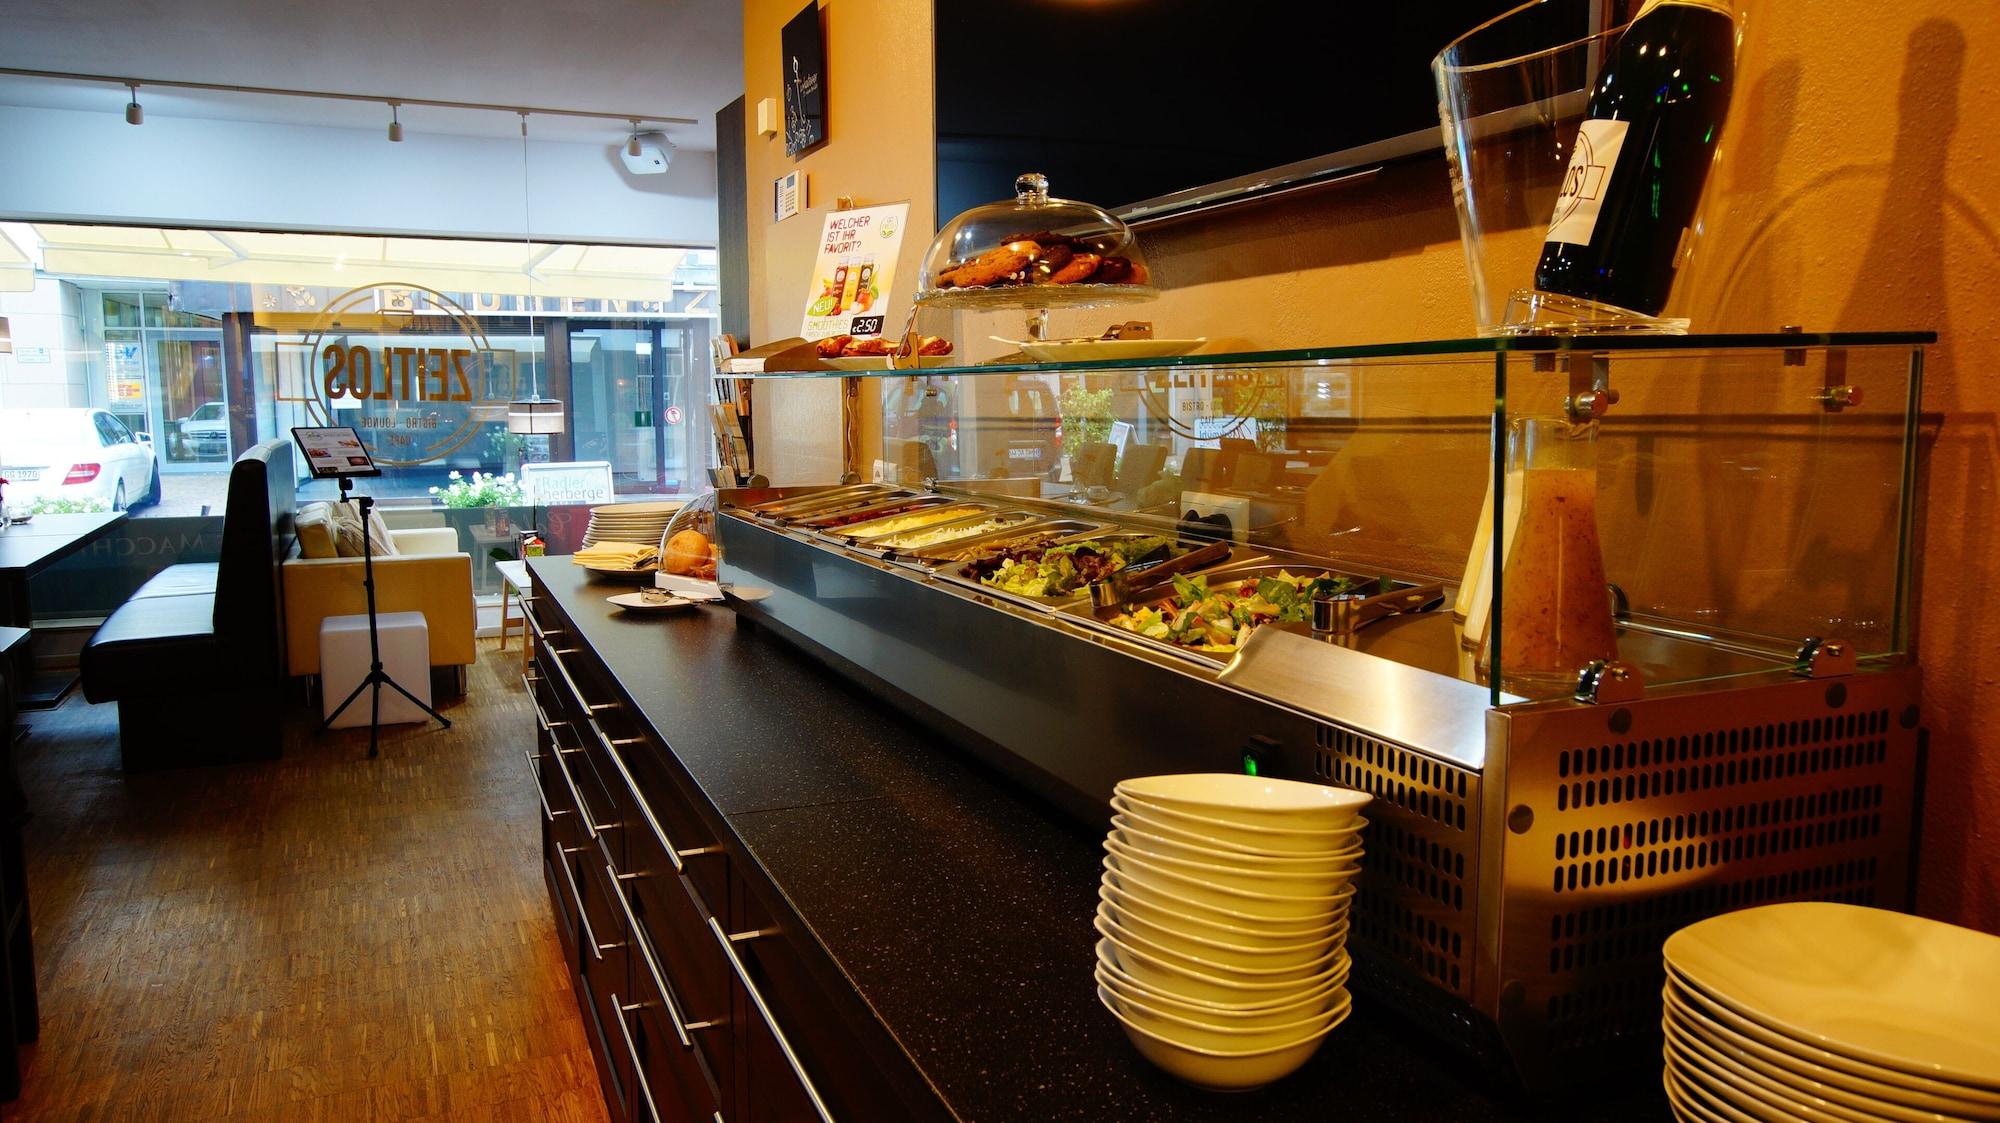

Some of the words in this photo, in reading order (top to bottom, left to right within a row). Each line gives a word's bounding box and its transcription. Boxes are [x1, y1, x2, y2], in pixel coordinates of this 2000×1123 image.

[829, 215, 871, 230] WELCHER
[827, 231, 840, 242] IST
[842, 229, 856, 242] IHR
[824, 240, 861, 254] FAVORIT?
[813, 298, 833, 314] NEU!
[1182, 401, 1204, 412] BISTRO
[544, 487, 604, 500] herberge
